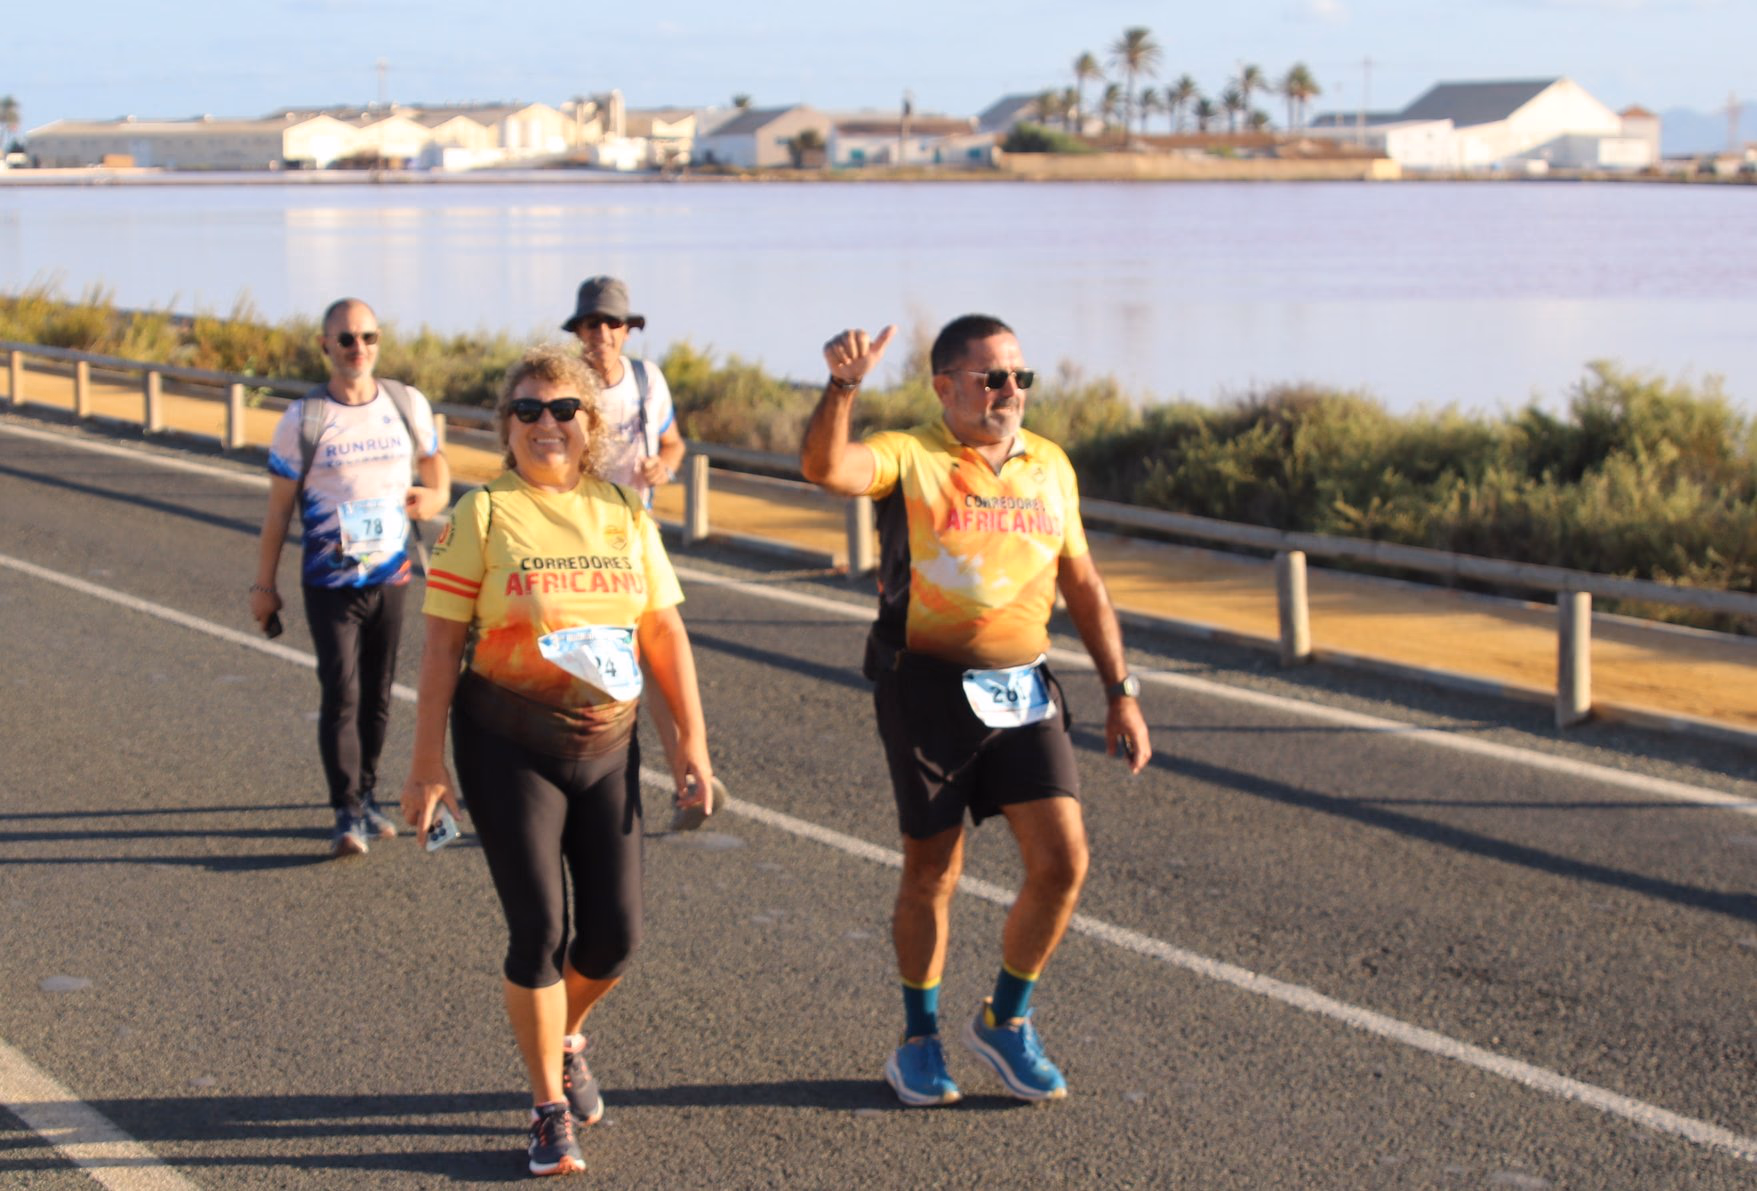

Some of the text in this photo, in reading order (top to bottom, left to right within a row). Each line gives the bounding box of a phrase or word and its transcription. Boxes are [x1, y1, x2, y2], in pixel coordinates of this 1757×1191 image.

[325, 437, 401, 456] RUNRUN
[362, 518, 383, 535] 78
[521, 555, 632, 570] CORREDORES
